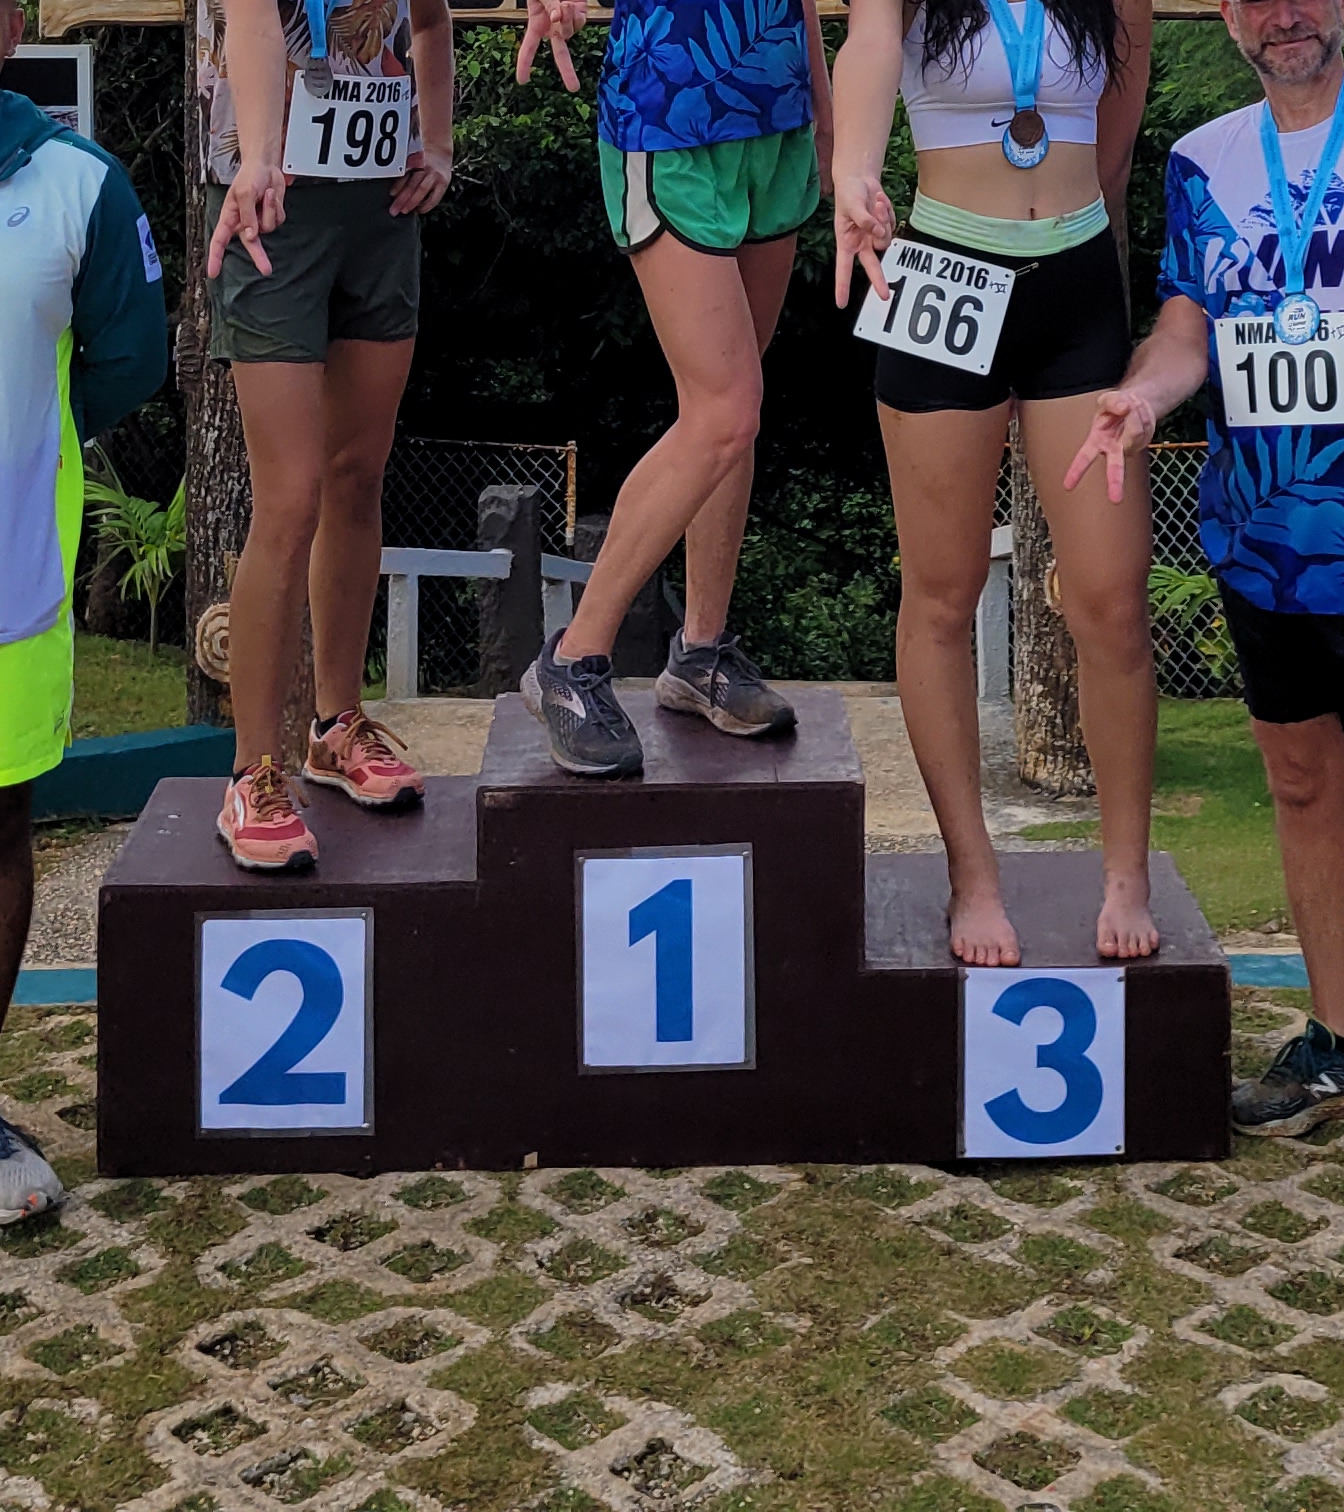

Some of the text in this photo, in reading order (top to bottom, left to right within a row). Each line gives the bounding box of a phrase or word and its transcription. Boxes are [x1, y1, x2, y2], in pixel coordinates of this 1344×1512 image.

[316, 79, 361, 103] MA
[365, 81, 401, 104] 2016
[311, 106, 400, 167] 198
[895, 245, 990, 290] NMA 2016
[882, 274, 984, 356] 166
[1235, 321, 1277, 346] NMA
[1236, 349, 1338, 414] 100
[629, 879, 693, 1043] 1
[219, 938, 346, 1106] 2
[983, 977, 1103, 1145] 3
